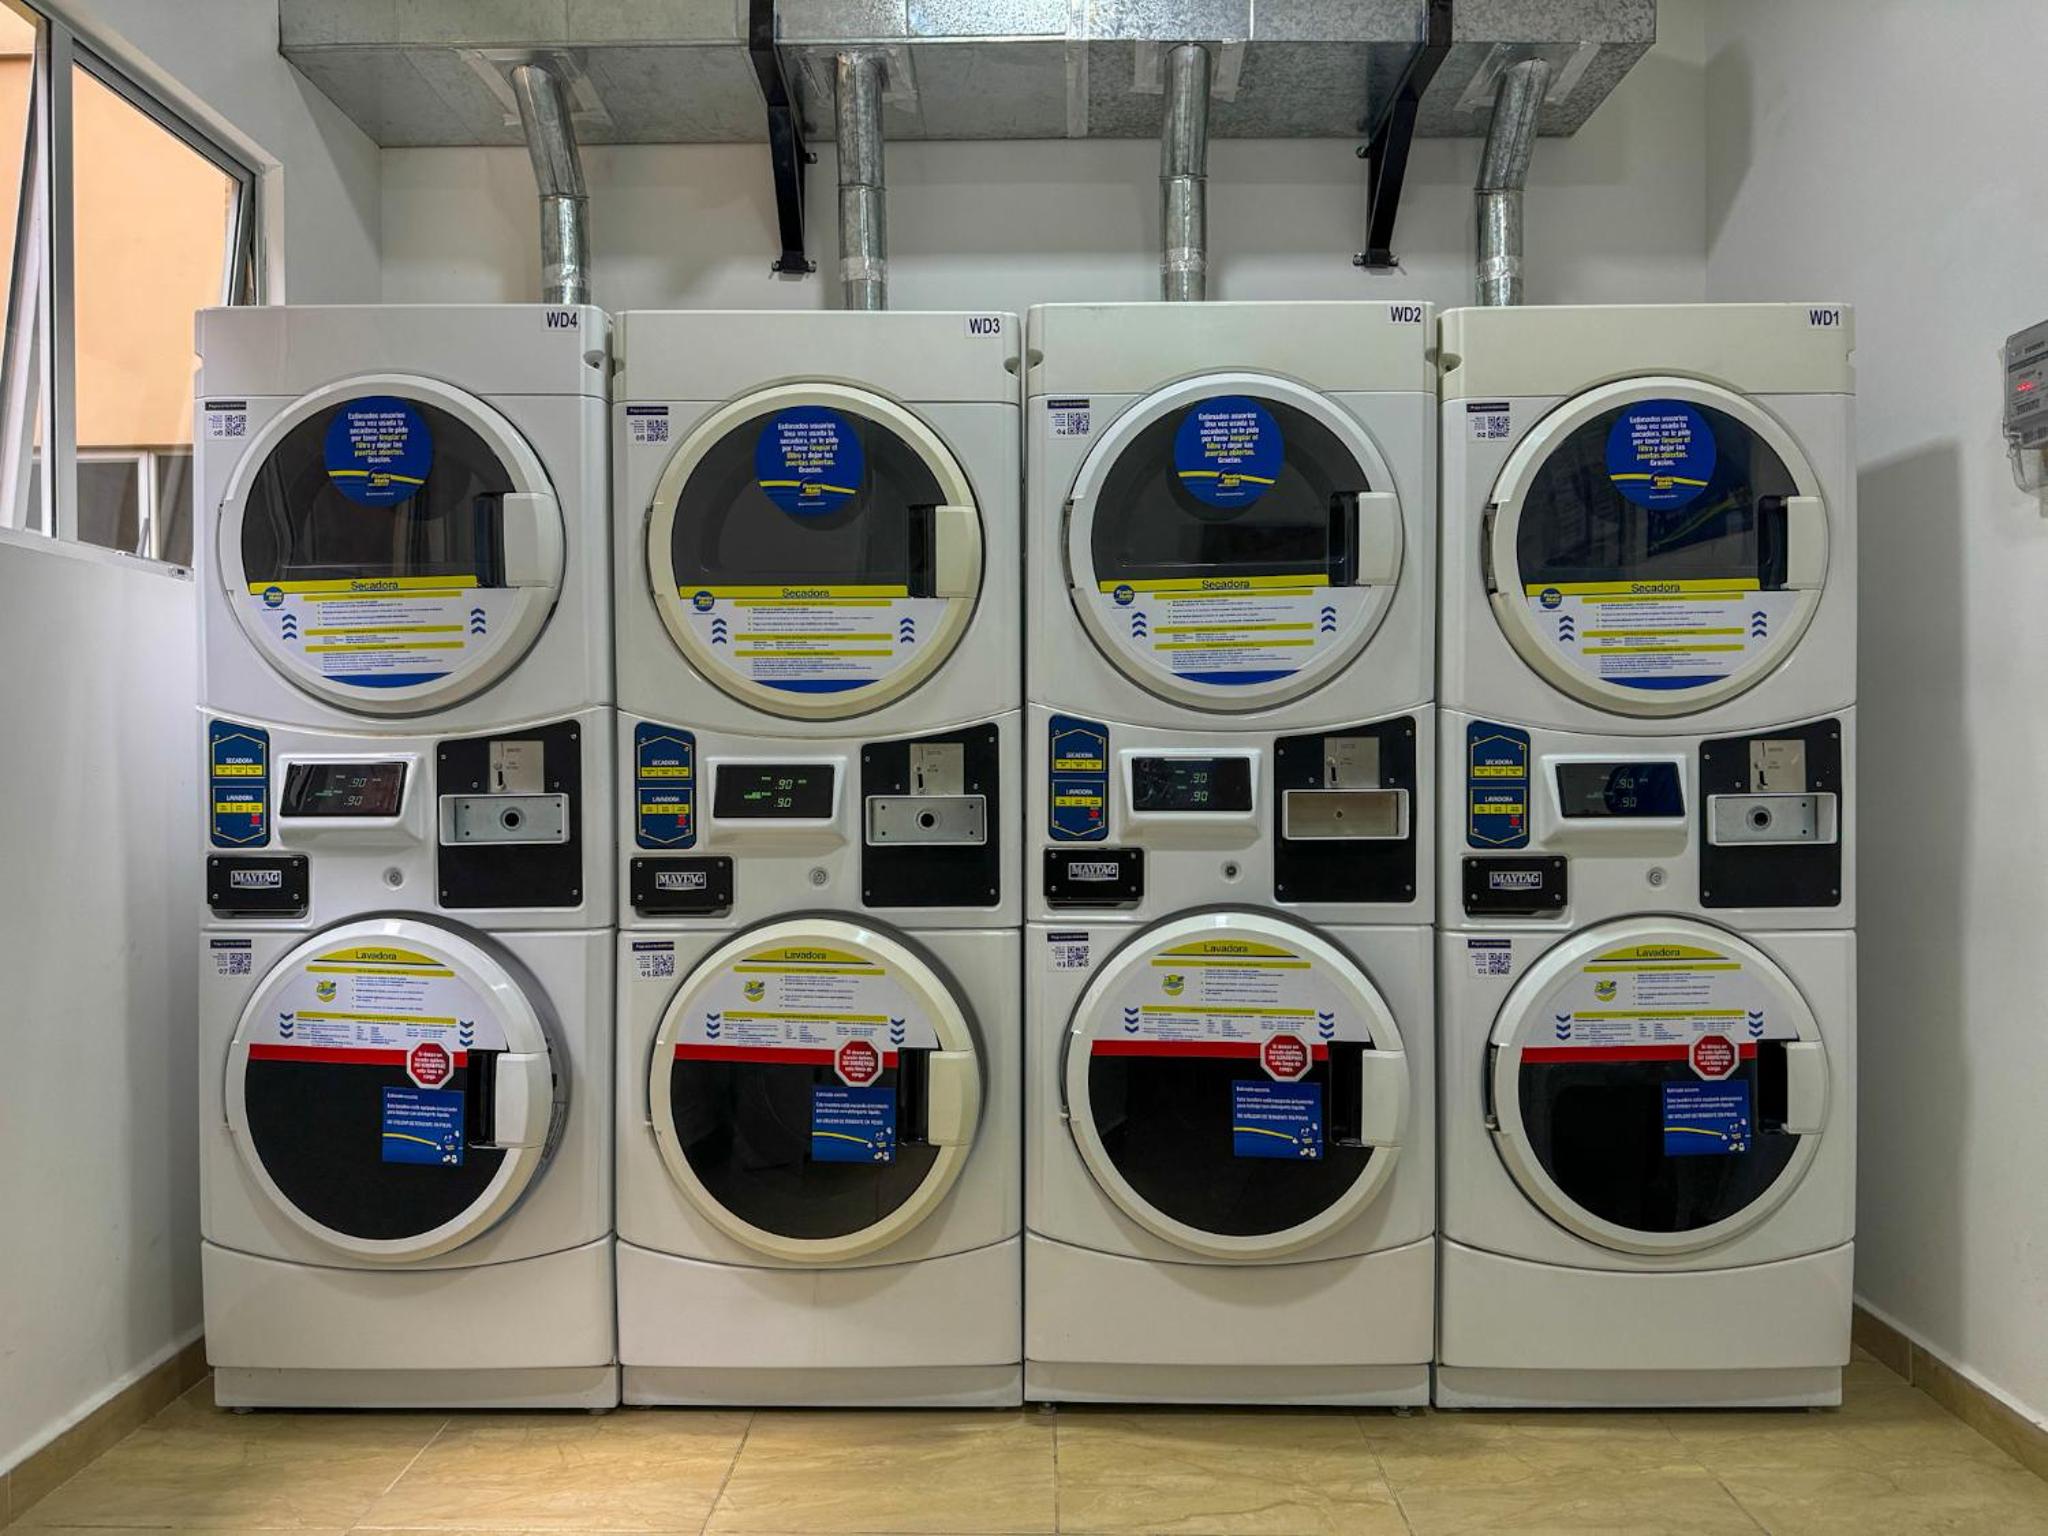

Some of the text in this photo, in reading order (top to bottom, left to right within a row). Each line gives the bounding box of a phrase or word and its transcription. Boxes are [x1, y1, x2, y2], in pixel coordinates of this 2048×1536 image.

[1391, 307, 1421, 322] WD2
[1810, 310, 1839, 325] WD1
[546, 313, 577, 327] WD4
[970, 318, 1000, 333] WD3
[351, 581, 398, 590] Secadora
[1202, 580, 1250, 589] Secadora
[1631, 583, 1680, 592] Secadora
[782, 588, 829, 598] Secadora
[1071, 865, 1116, 874] MAYTAG
[234, 872, 279, 882] MAYTAG
[658, 874, 703, 883] MAYTAG
[1493, 873, 1539, 882] MAYTAG
[1204, 944, 1248, 953] Lavadora
[1636, 948, 1680, 957] Lavadora
[356, 951, 397, 960] Lavadora
[785, 951, 827, 960] Lavadora
